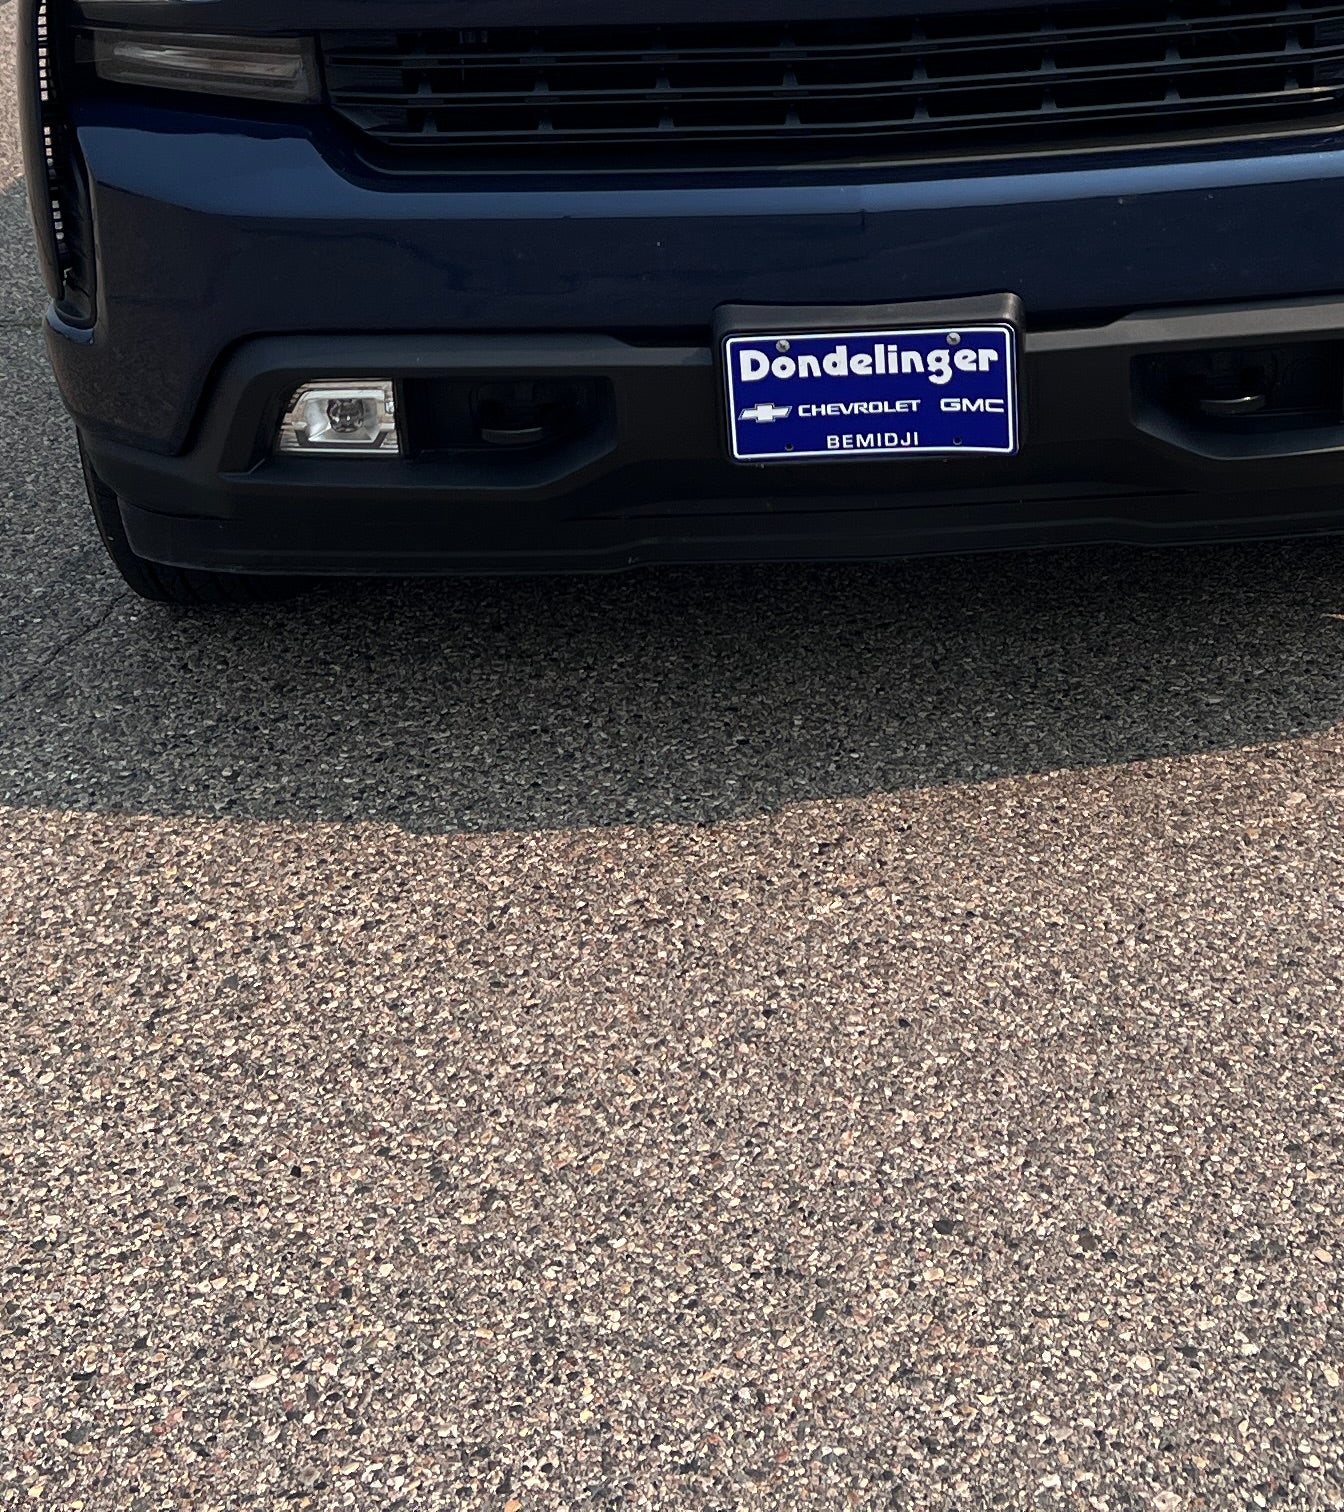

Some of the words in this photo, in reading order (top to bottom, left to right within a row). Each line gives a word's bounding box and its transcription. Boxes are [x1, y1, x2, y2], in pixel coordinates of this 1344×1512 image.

[739, 343, 999, 385] Dondelinger
[798, 399, 921, 417] CHEVROLET
[940, 398, 1005, 413] GMC
[827, 432, 919, 449] BEMIDJI
